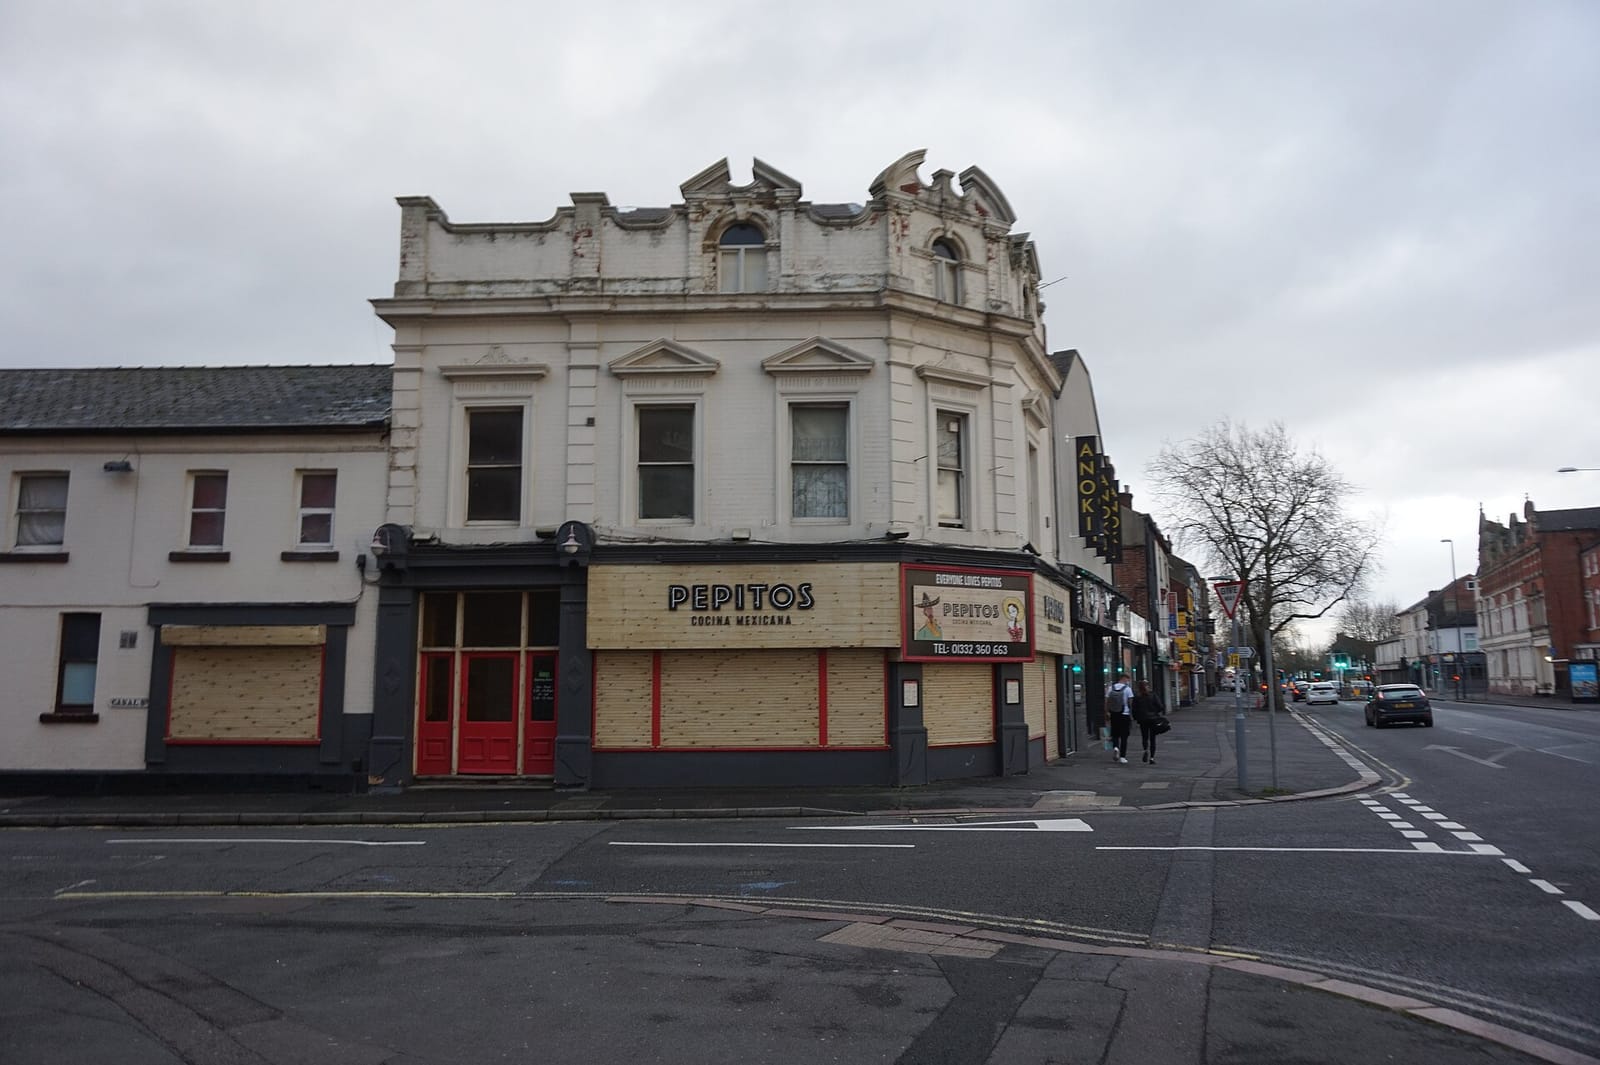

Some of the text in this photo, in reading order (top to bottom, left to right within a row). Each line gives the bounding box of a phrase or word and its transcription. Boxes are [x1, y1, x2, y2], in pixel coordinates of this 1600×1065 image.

[1080, 442, 1096, 531] ANOKI
[936, 574, 1002, 588] EVERYONE LOVES PEPITOS
[668, 583, 815, 611] PEPITOS
[943, 603, 1000, 618] PEPITOS
[691, 615, 792, 626] COCINA MEXICANA
[933, 643, 1008, 655] TEL: 01332 360 663
